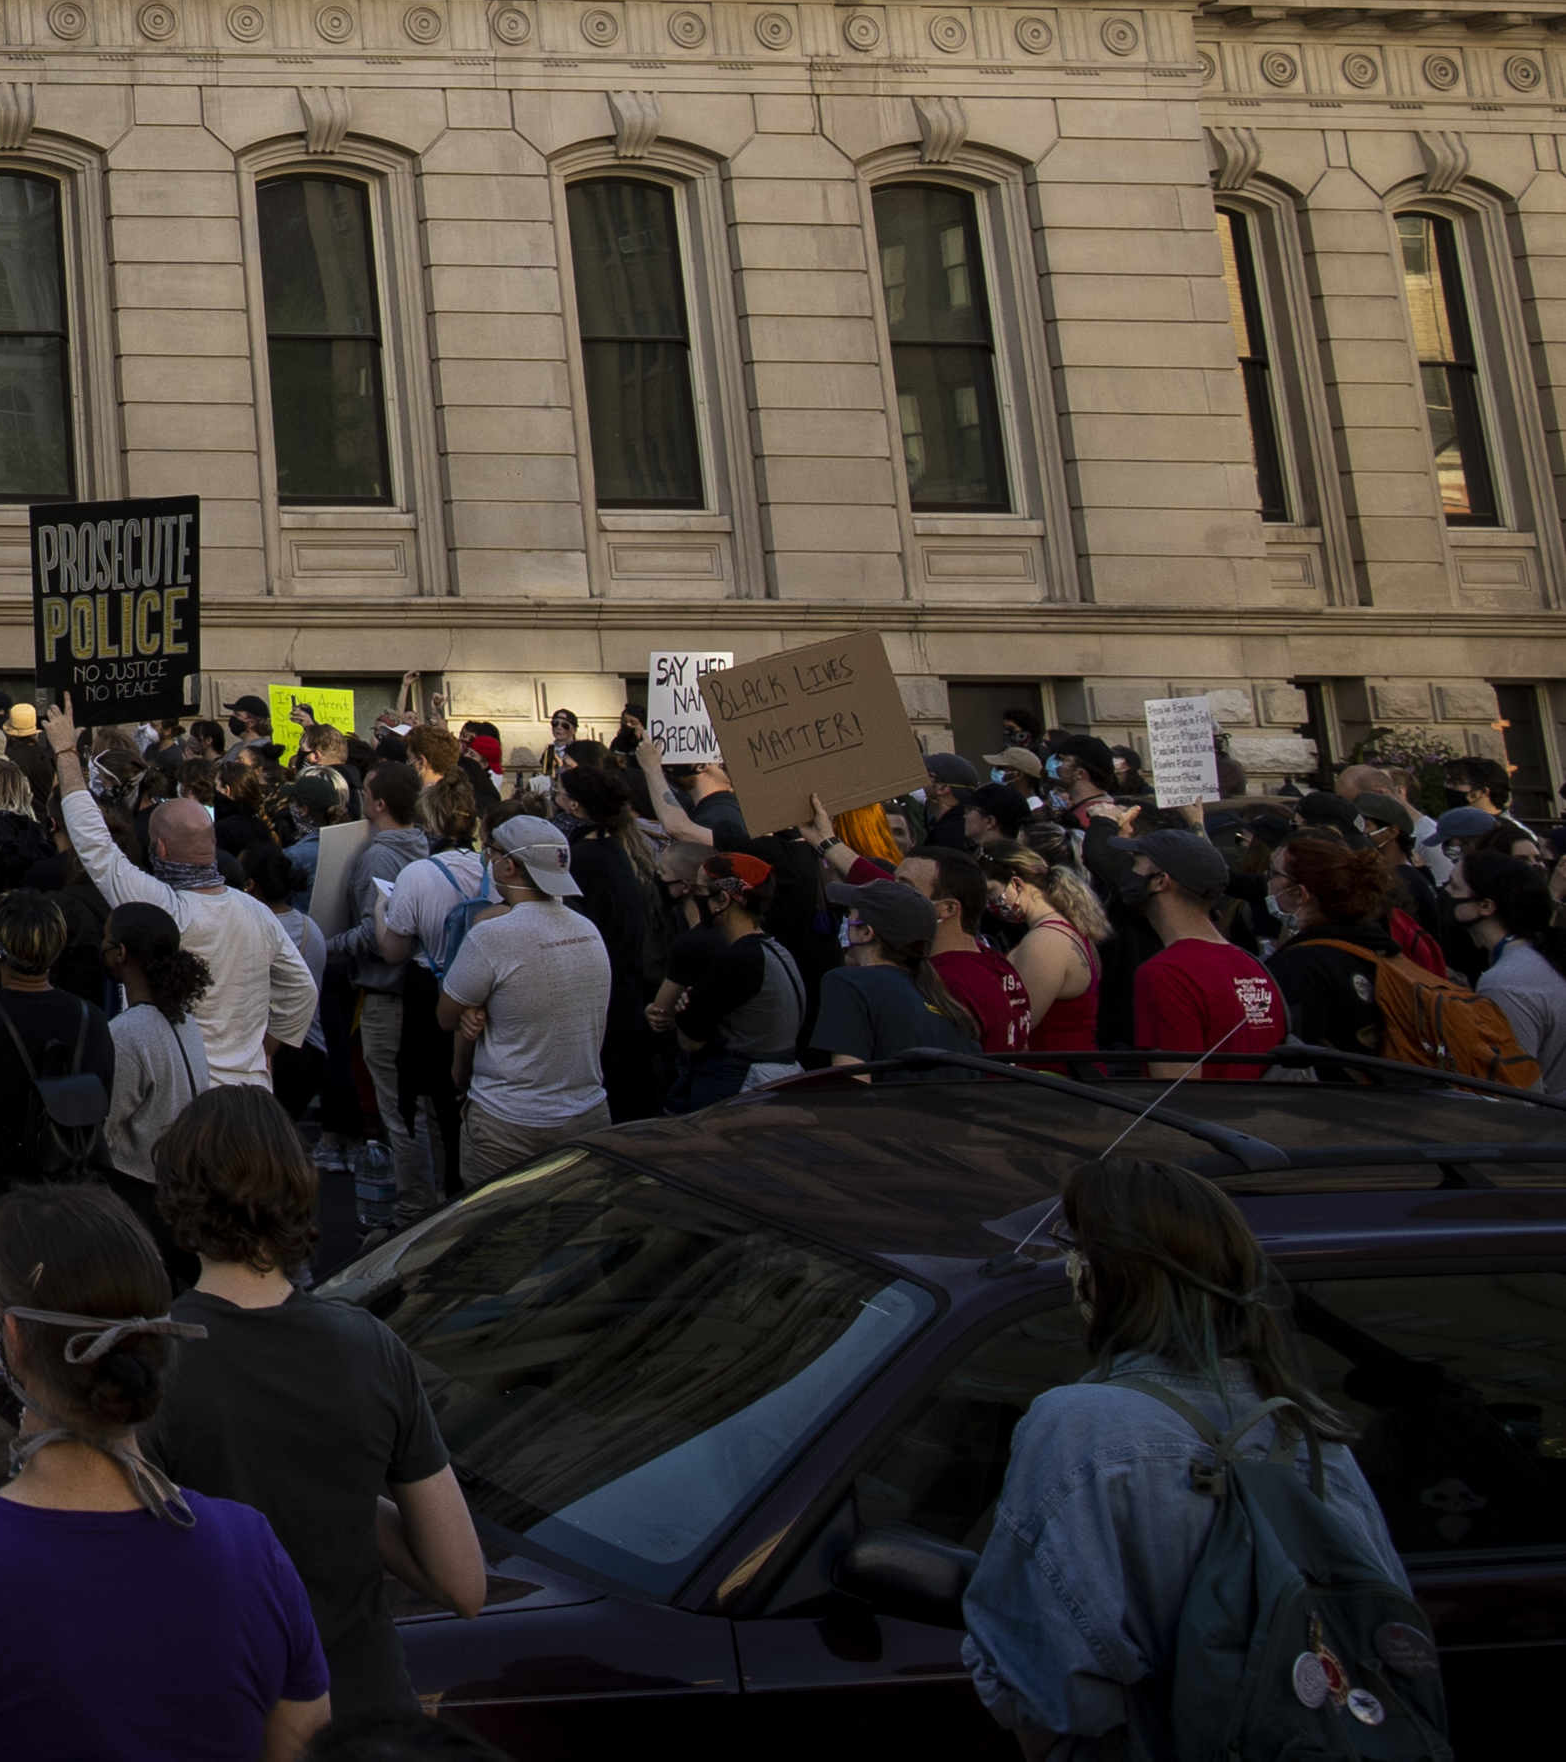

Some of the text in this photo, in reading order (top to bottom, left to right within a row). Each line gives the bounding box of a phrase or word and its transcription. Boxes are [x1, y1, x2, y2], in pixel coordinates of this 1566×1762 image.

[38, 514, 193, 594] PROSECUTE
[42, 586, 189, 663] POLICE
[73, 660, 169, 684] NO JUSTICE
[85, 680, 161, 702] NO PEACE
[655, 655, 689, 687] SAY
[709, 653, 855, 721] BLACK LIVES
[747, 710, 865, 769] MATTER!
